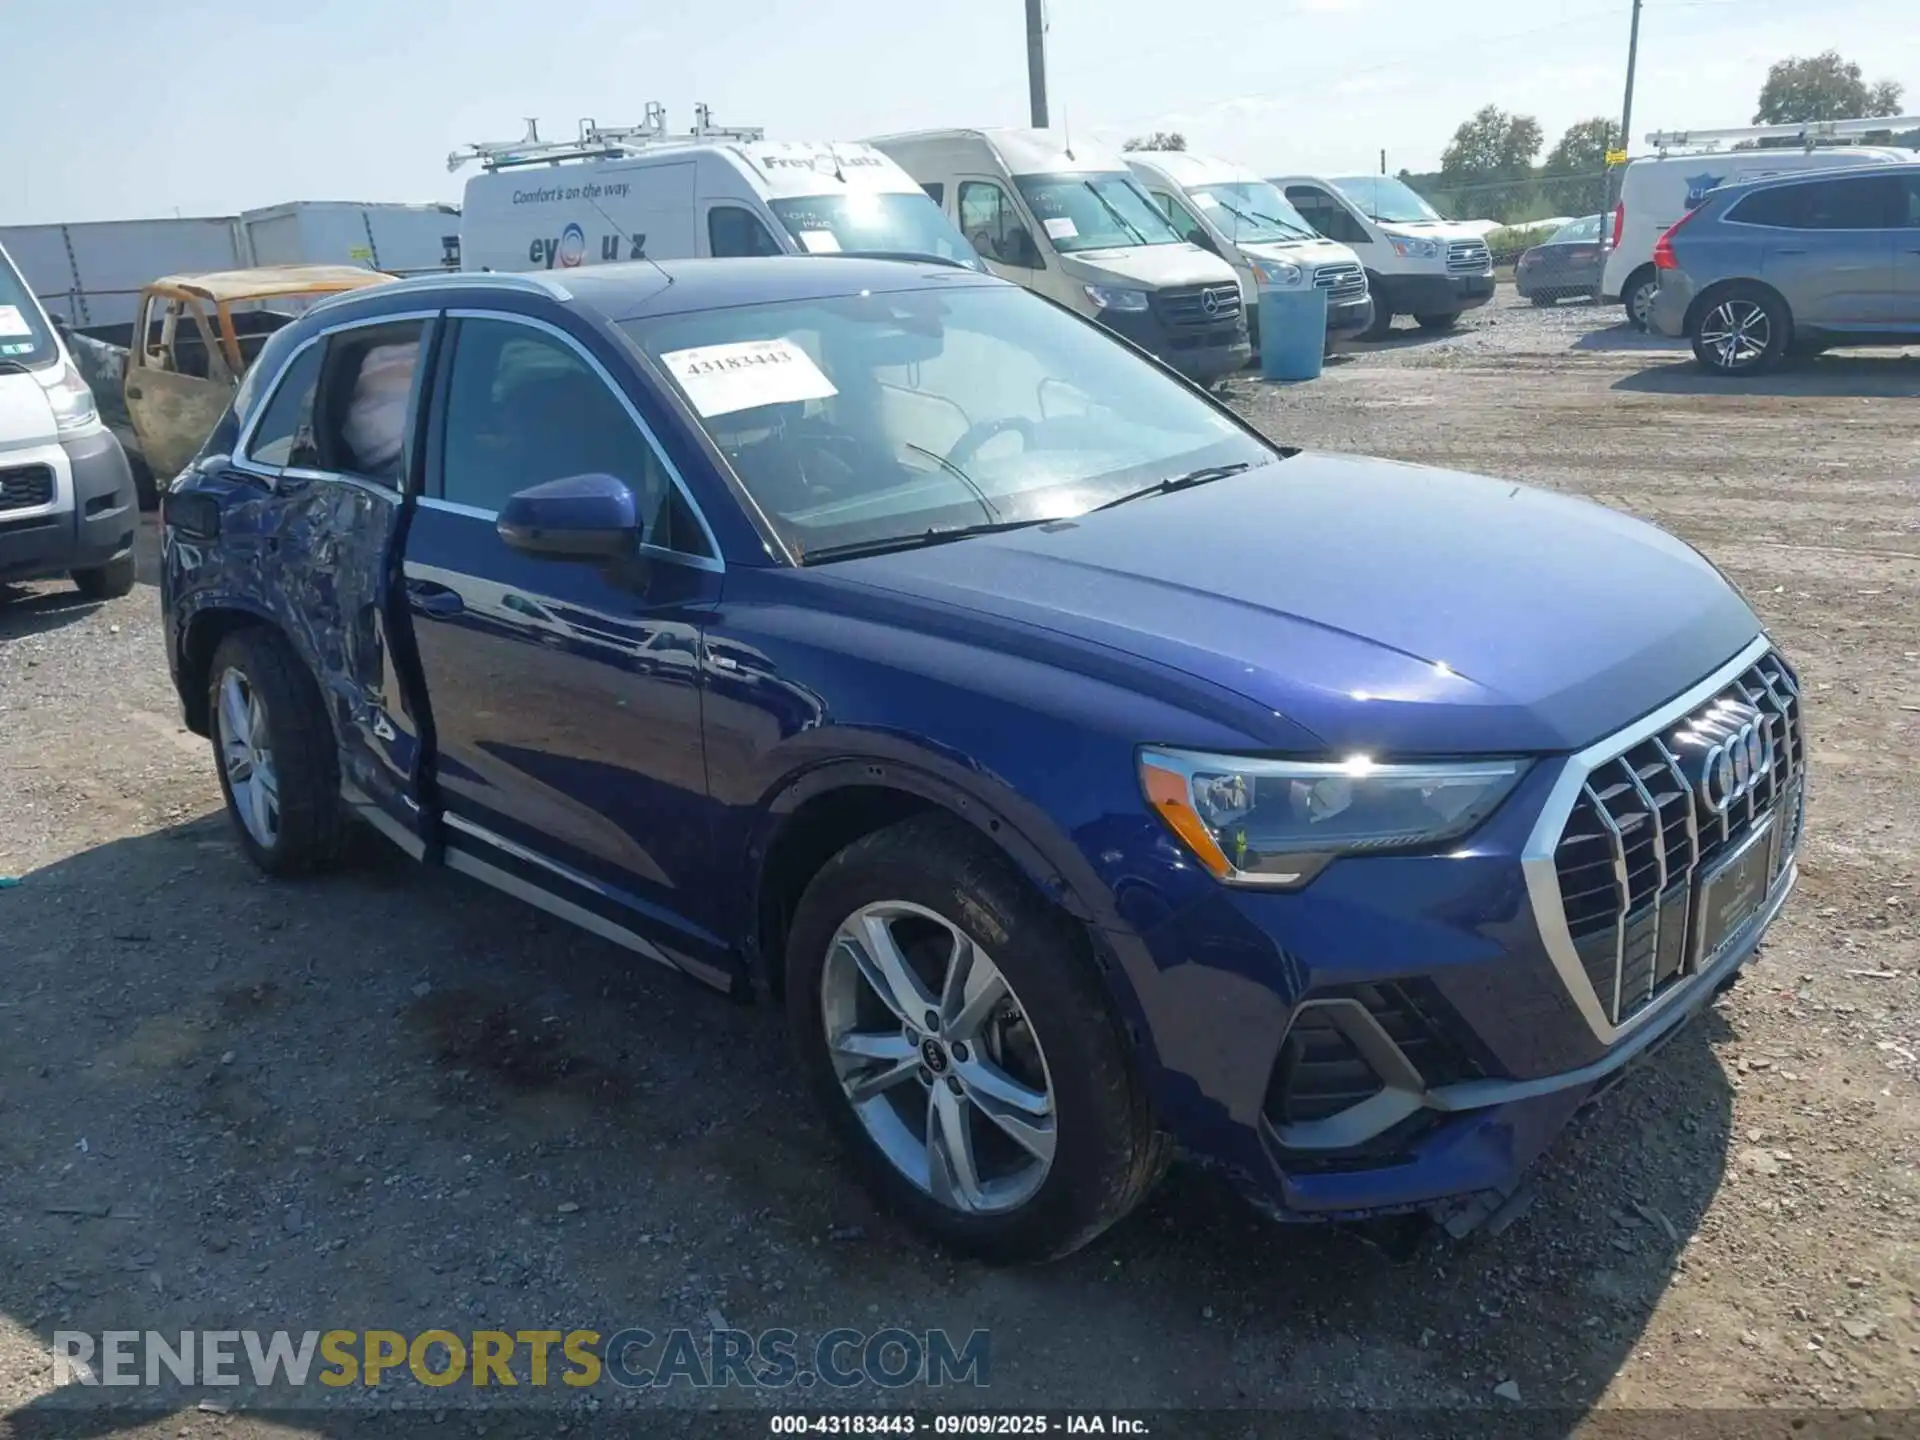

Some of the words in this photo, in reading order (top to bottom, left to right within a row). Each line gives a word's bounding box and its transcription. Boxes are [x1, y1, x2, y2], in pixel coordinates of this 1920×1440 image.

[762, 155, 815, 171] Frey
[512, 187, 563, 204] Comfort's
[566, 187, 580, 200] on
[582, 183, 601, 198] the
[688, 351, 792, 376] 43183443
